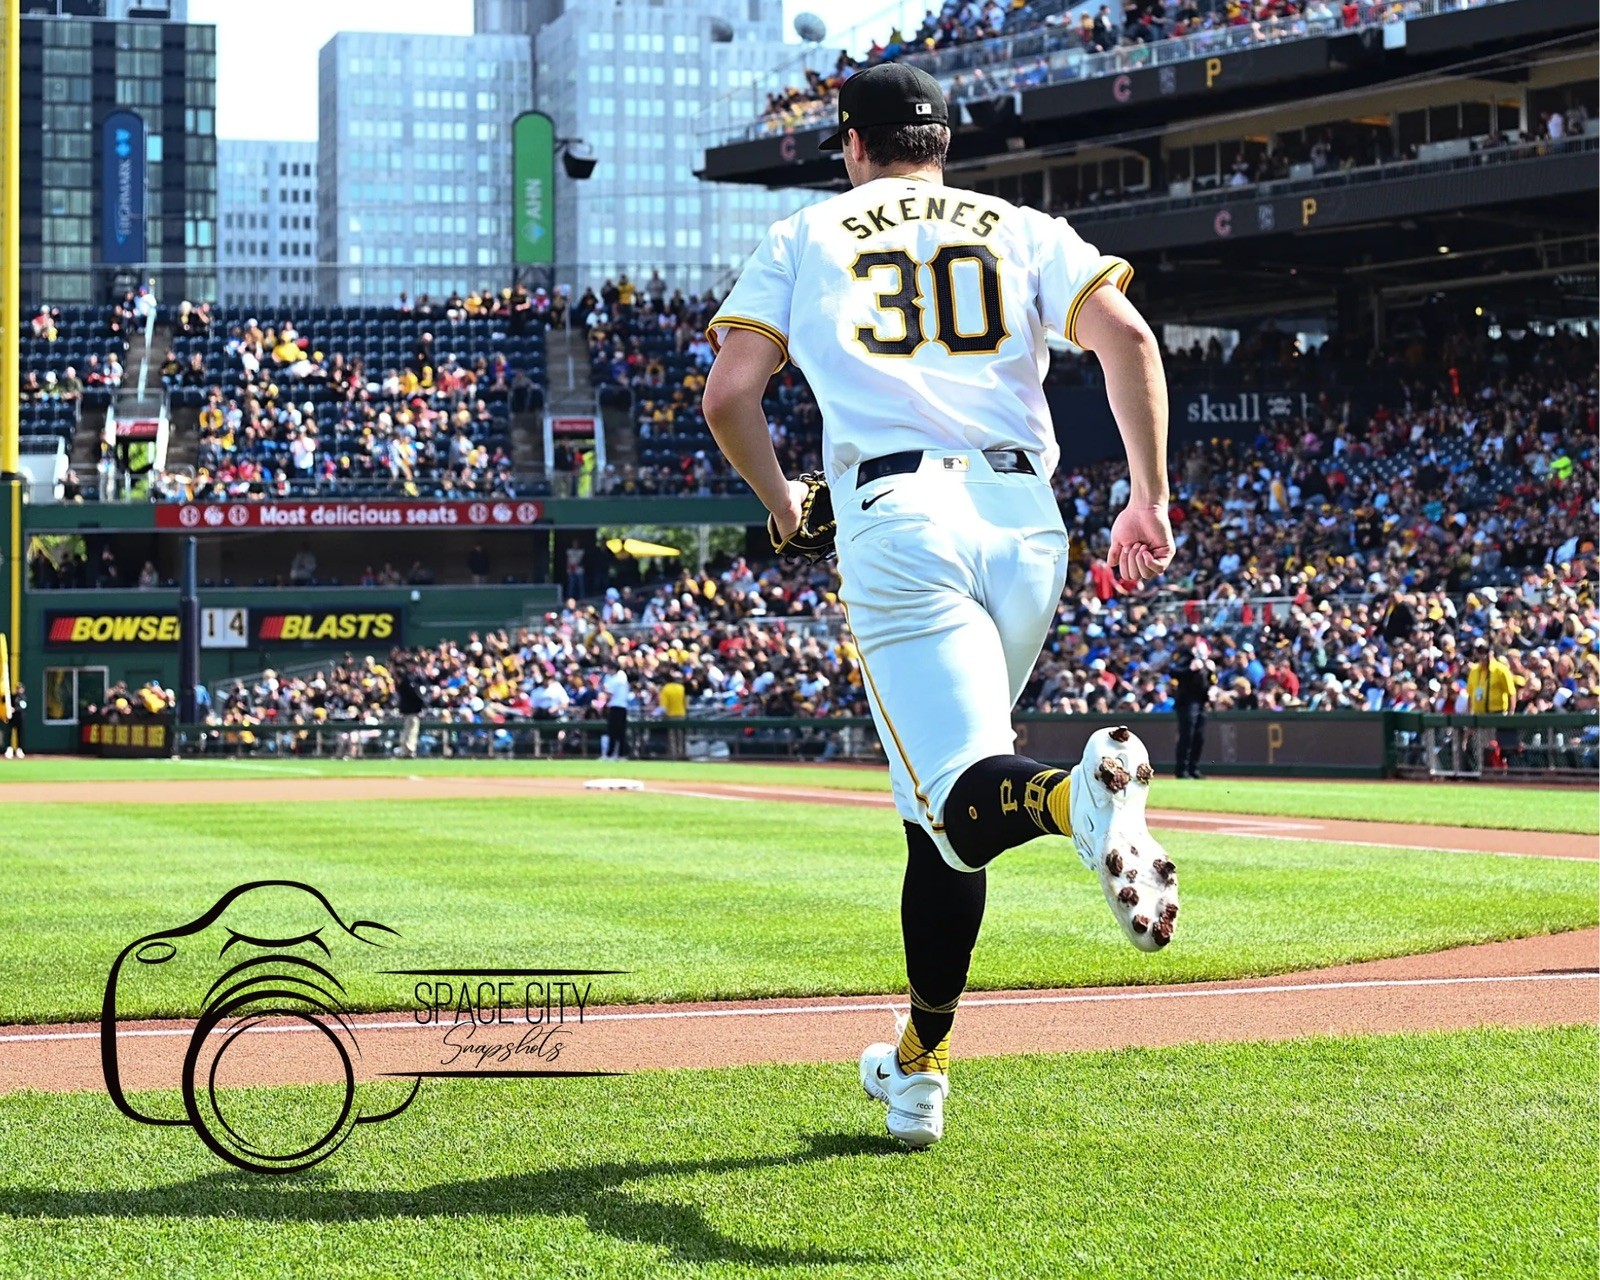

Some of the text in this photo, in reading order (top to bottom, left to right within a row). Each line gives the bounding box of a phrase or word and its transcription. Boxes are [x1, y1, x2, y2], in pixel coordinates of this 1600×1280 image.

[1206, 58, 1222, 88] P
[525, 178, 542, 219] AHN
[1302, 198, 1317, 226] P
[840, 197, 1001, 240] SKENES
[848, 241, 1012, 358] 30
[1187, 393, 1260, 421] skull
[260, 504, 458, 525] Most delicious seats
[280, 613, 394, 640] BLASTS
[1267, 723, 1283, 764] P
